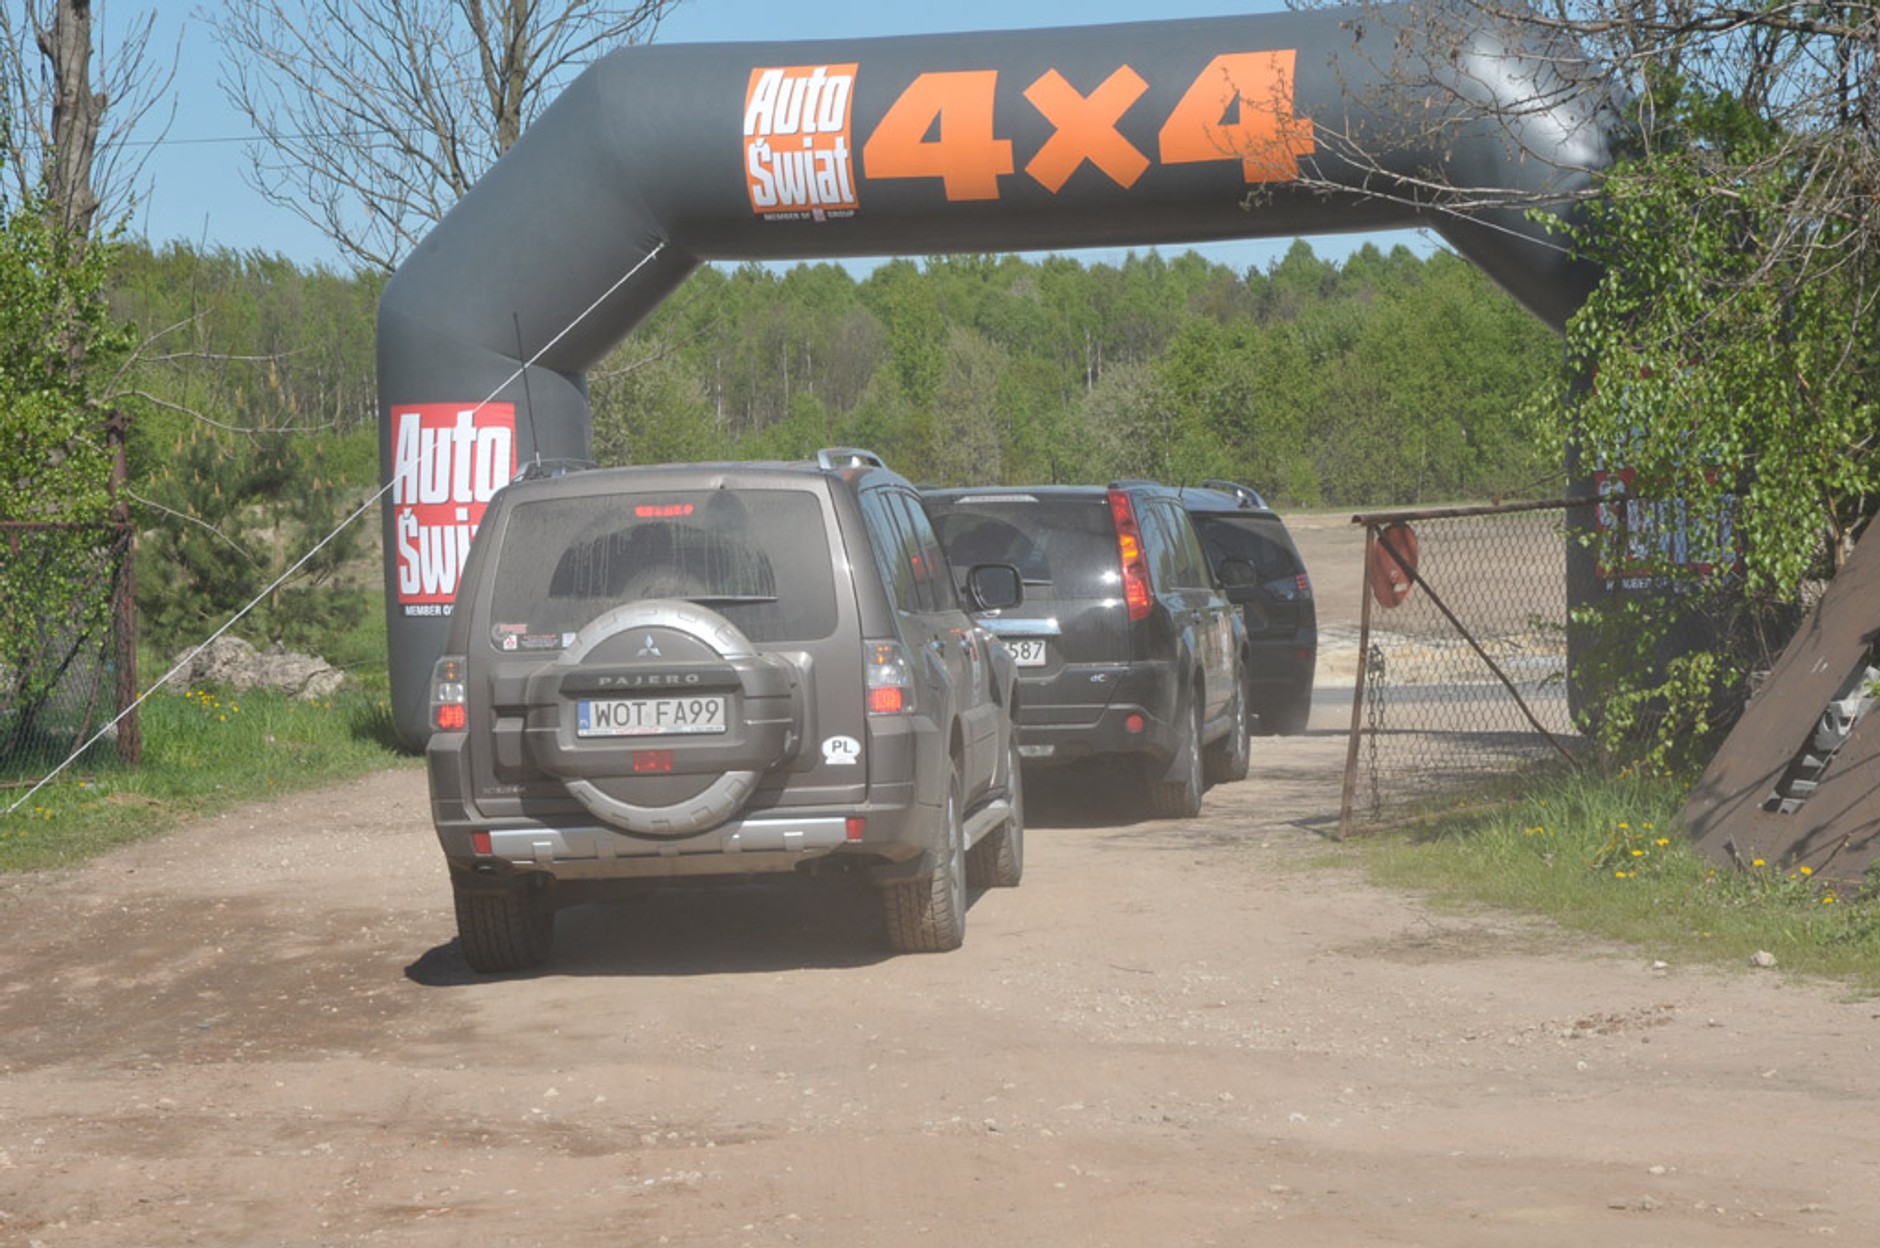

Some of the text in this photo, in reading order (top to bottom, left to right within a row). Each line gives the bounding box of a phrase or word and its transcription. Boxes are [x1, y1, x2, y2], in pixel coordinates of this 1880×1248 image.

[743, 65, 851, 135] Auto
[862, 48, 1316, 201] 4x4
[748, 136, 855, 207] Świat
[393, 410, 512, 505] Auto
[405, 604, 442, 616] MEMBER
[598, 673, 700, 686] PAJERO
[594, 699, 720, 728] WOT FA99
[831, 739, 853, 754] PL
